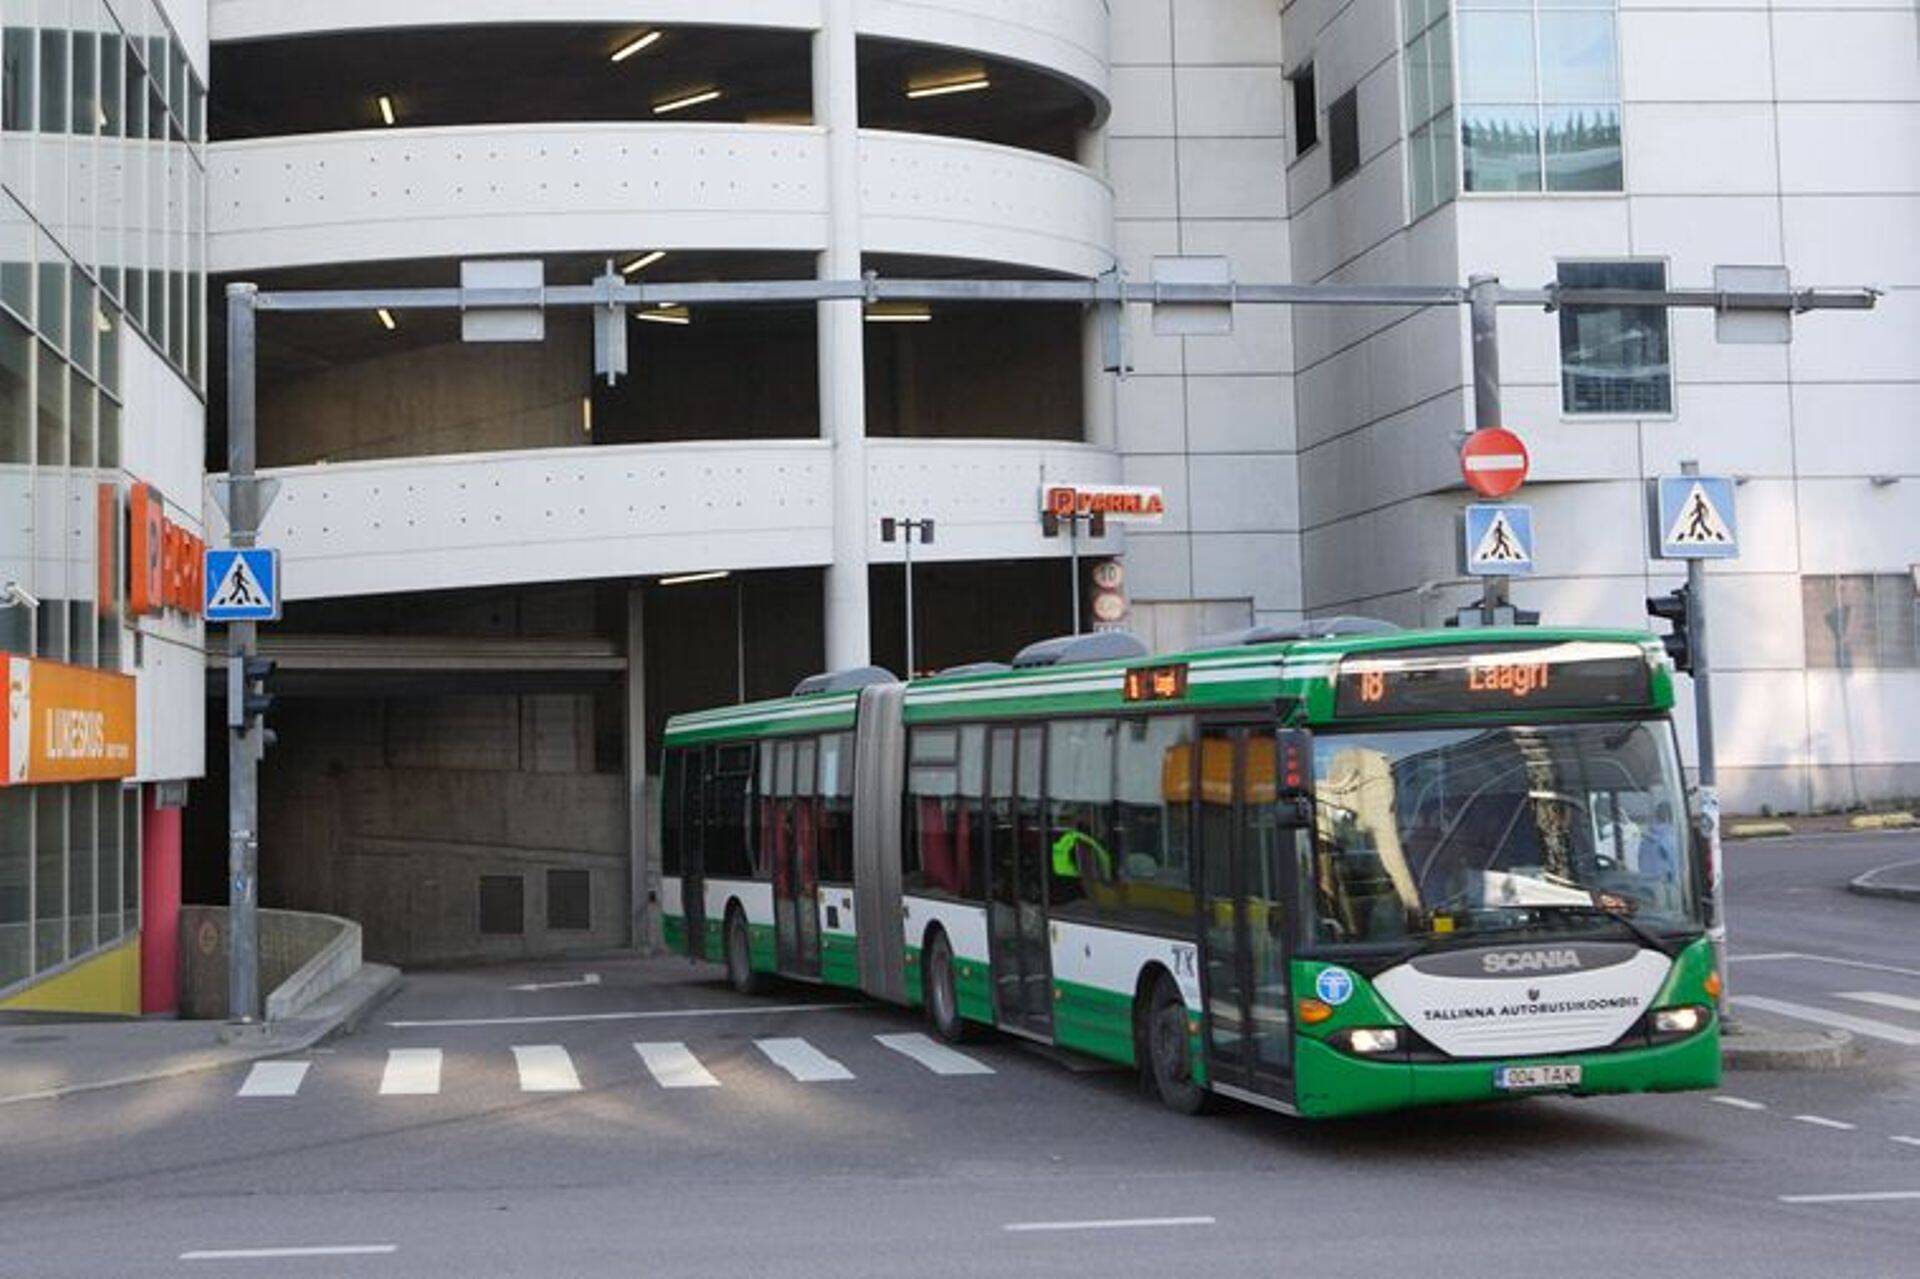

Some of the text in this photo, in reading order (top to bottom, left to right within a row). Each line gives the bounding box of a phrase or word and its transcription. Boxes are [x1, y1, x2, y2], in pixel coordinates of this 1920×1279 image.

[1482, 950, 1581, 973] SCANIA
[1423, 996, 1640, 1021] TALLINNA AUTOBUSSIKOONDIS
[1508, 1067, 1575, 1084] 004 TAK
